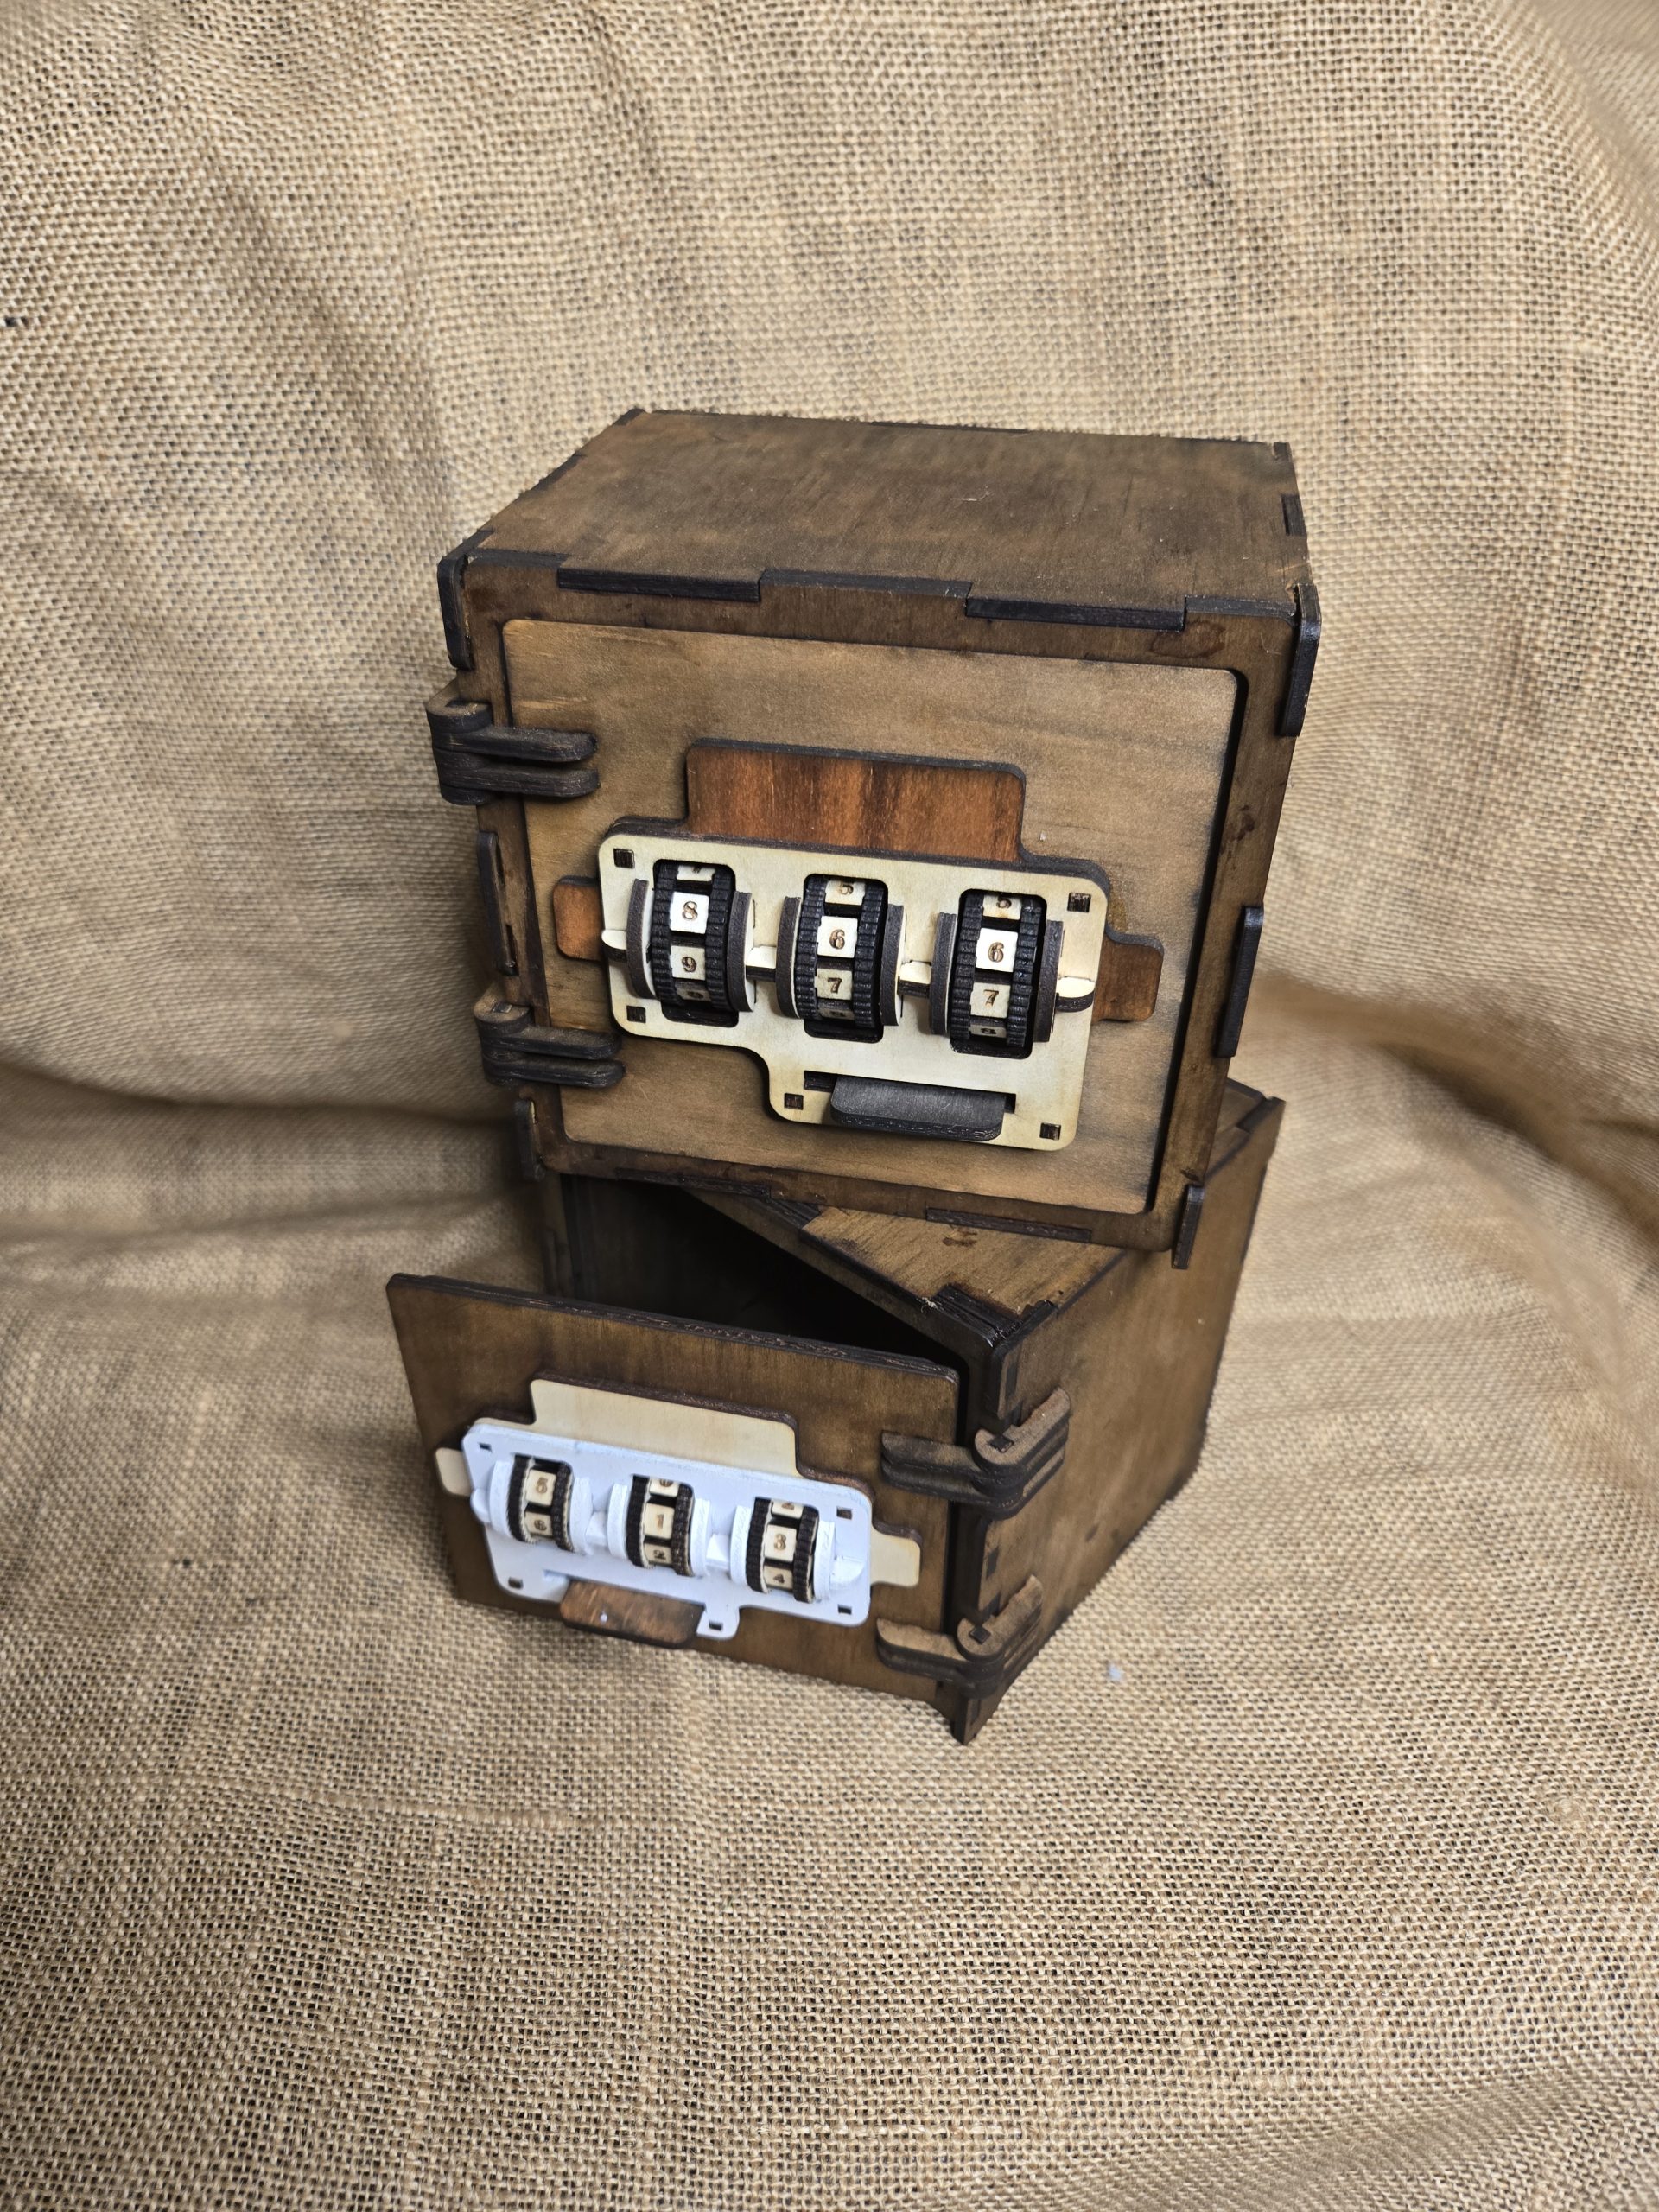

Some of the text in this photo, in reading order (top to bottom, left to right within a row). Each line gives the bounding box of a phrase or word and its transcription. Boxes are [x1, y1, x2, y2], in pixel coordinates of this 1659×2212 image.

[682, 900, 698, 920] 8
[830, 929, 846, 950] 6
[988, 941, 1005, 963] 6
[681, 956, 697, 973] 9
[827, 976, 842, 995] 7
[982, 989, 1000, 1007] 7
[536, 1476, 549, 1494] 5
[655, 1513, 664, 1529] 1
[773, 1533, 787, 1551] 3
